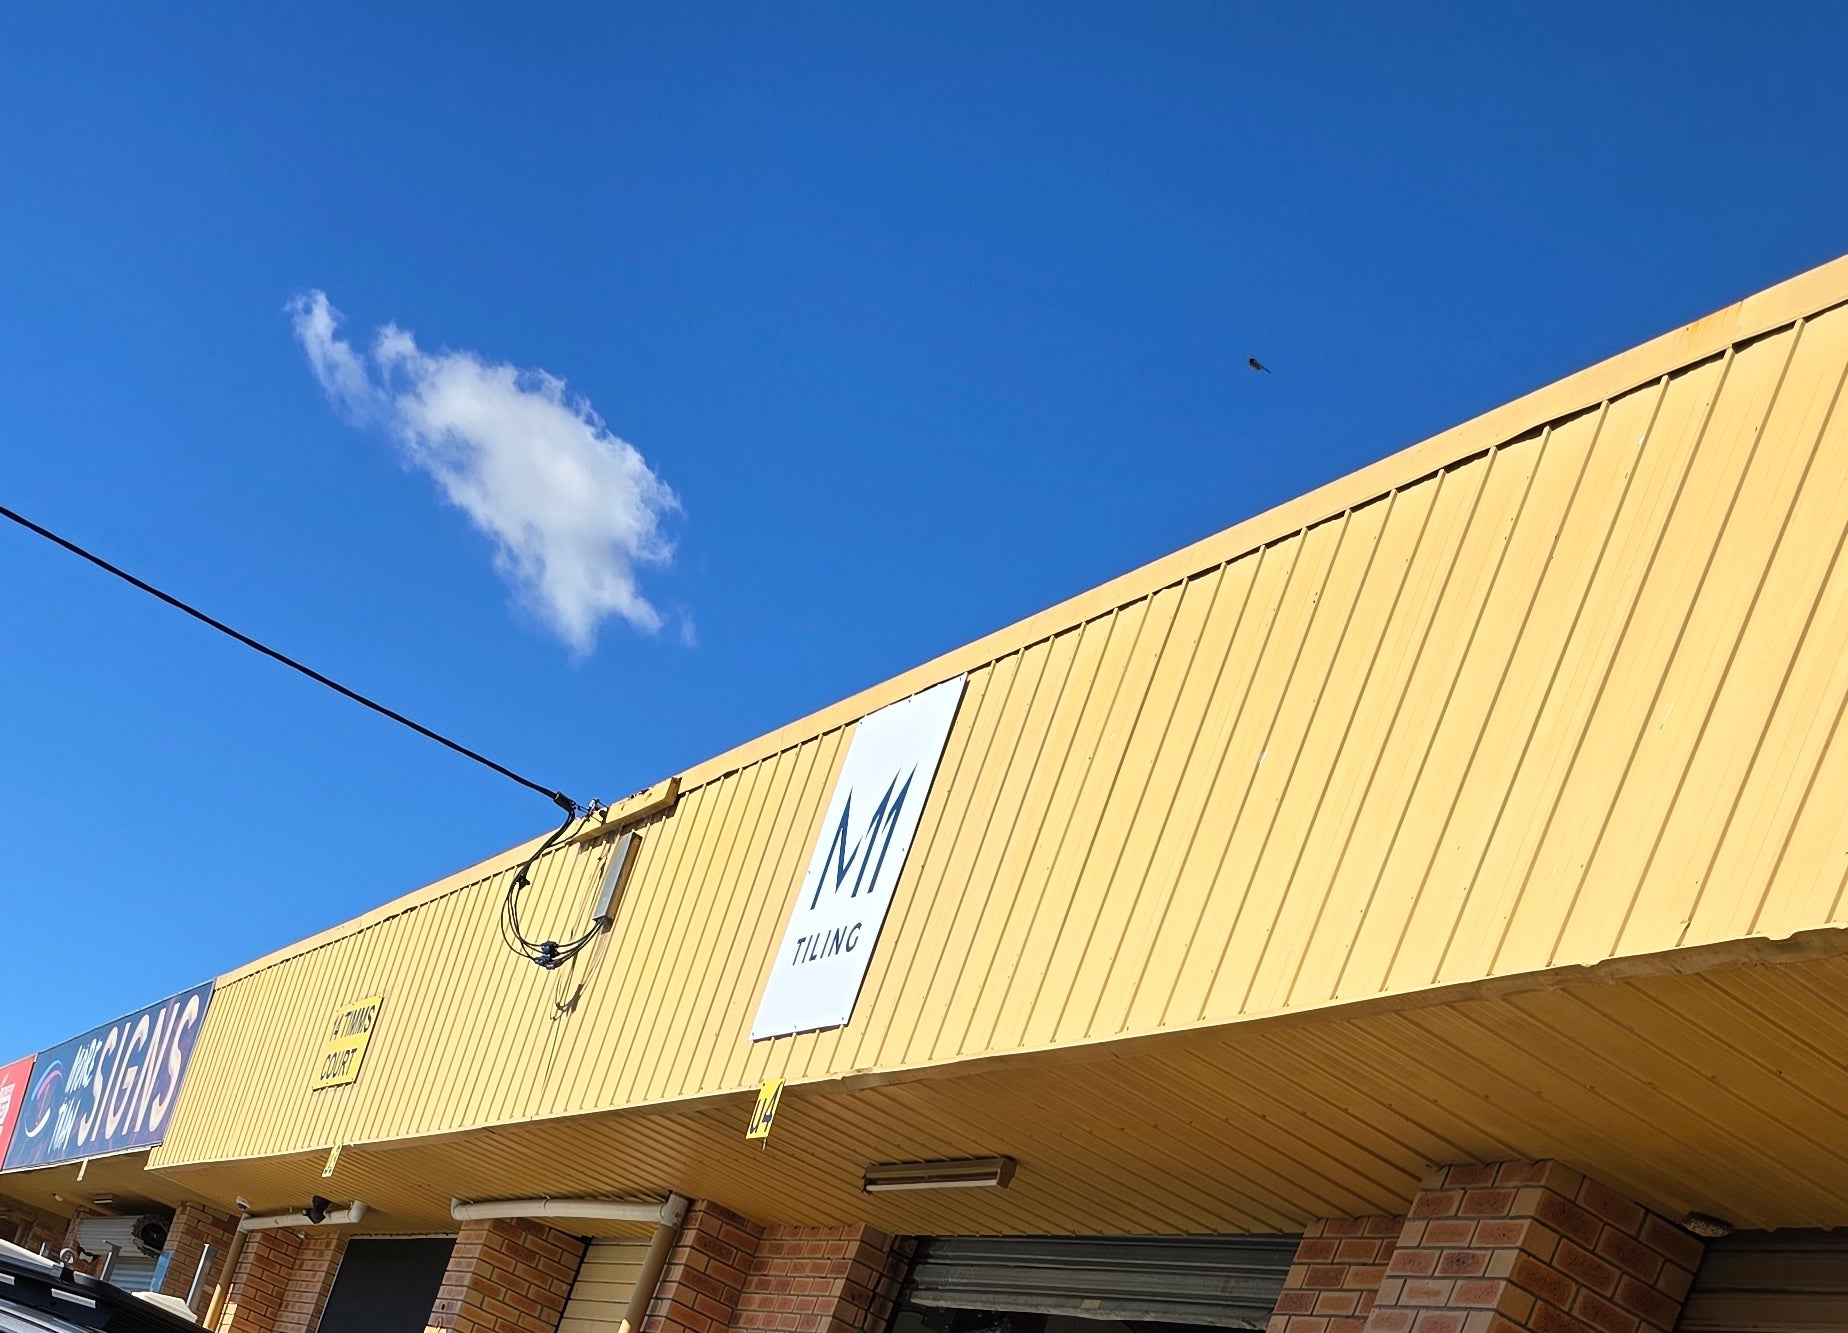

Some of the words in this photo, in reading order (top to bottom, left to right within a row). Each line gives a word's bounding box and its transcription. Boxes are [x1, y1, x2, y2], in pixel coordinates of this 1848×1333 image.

[792, 923, 863, 966] TILING
[340, 1004, 376, 1039] TIMMS
[77, 994, 200, 1147] SIGNS
[320, 1047, 358, 1081] COURT
